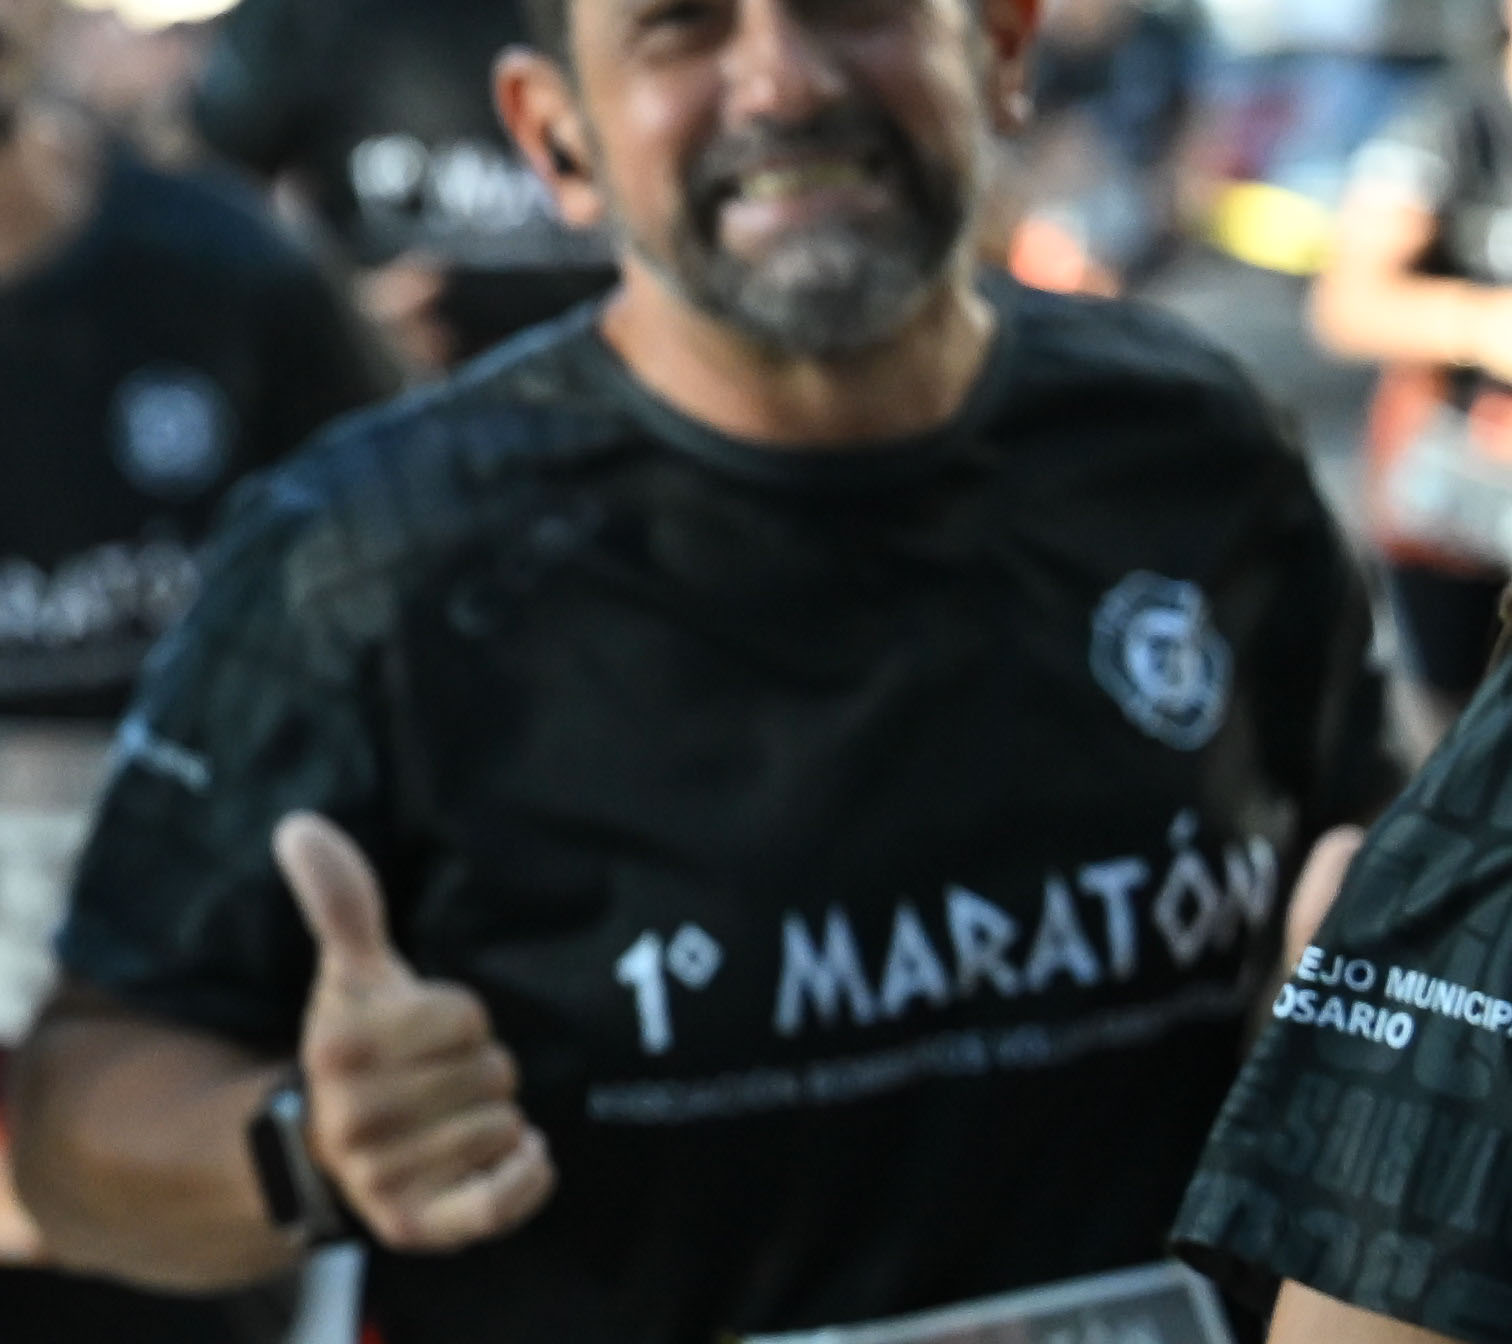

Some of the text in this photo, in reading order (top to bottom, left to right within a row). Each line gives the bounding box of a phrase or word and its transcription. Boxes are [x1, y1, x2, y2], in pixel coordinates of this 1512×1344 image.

[772, 808, 1277, 1040] MARATÓN
[1272, 982, 1414, 1050] OSARIO
[1384, 964, 1512, 1038] MUNICIP
